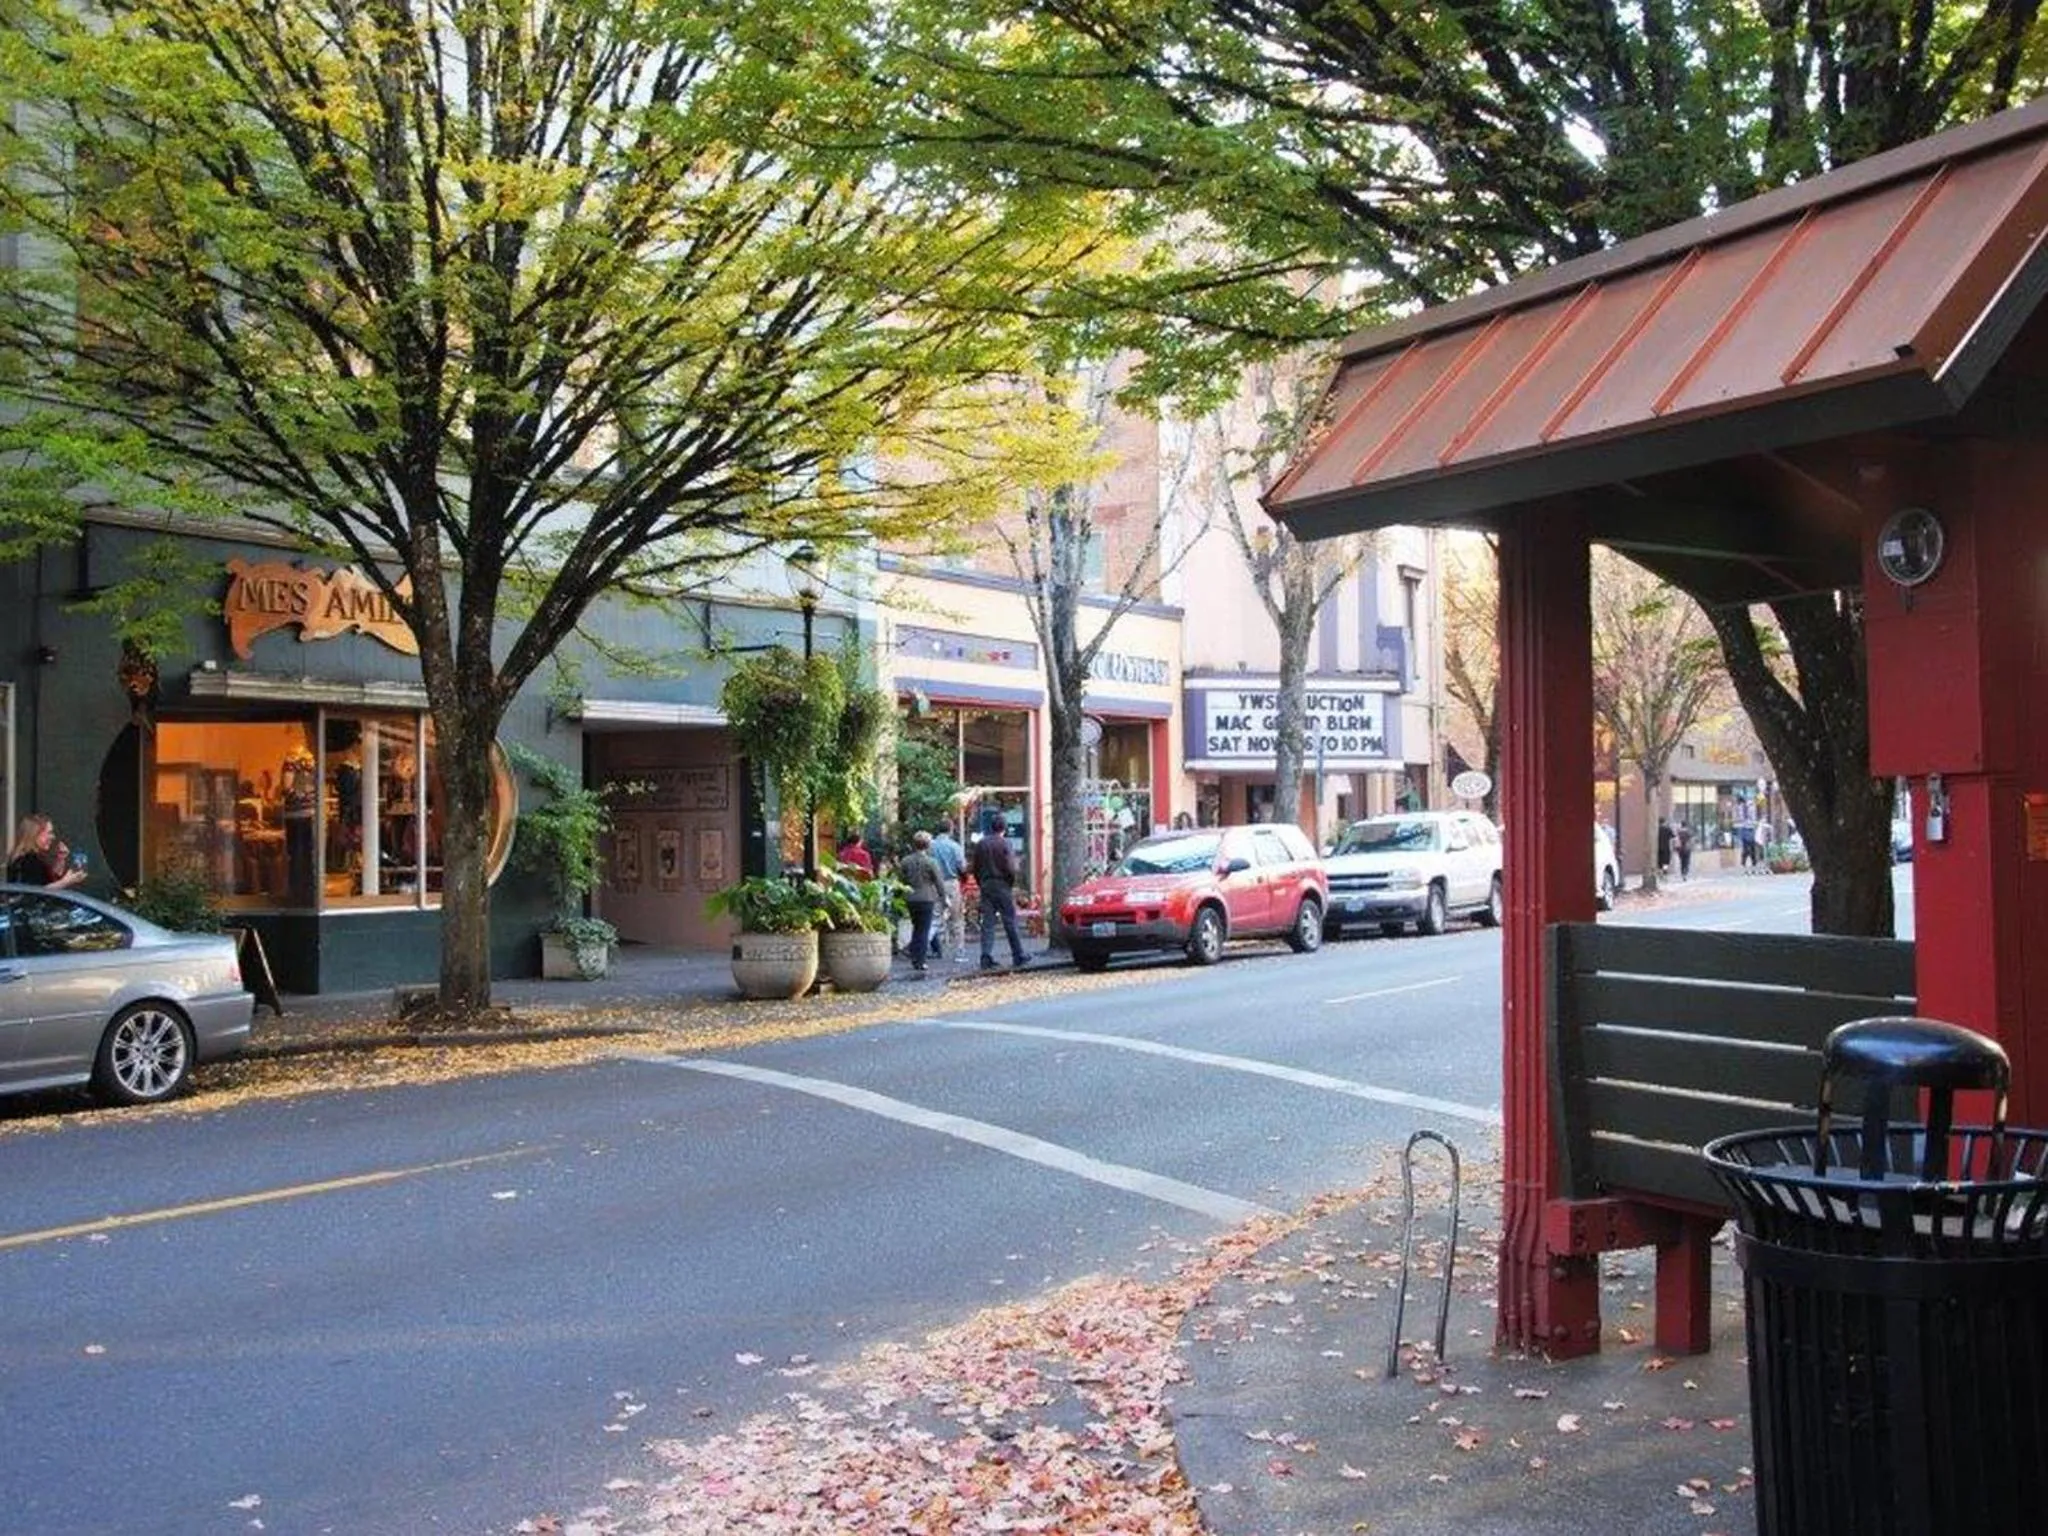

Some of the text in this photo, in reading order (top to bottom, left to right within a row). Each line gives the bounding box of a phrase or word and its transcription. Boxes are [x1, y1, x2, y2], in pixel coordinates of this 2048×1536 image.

[237, 577, 308, 616] MES
[1238, 694, 1365, 712] YWS UCTION
[1216, 715, 1252, 731] MAC
[1208, 736, 1241, 752] SAT
